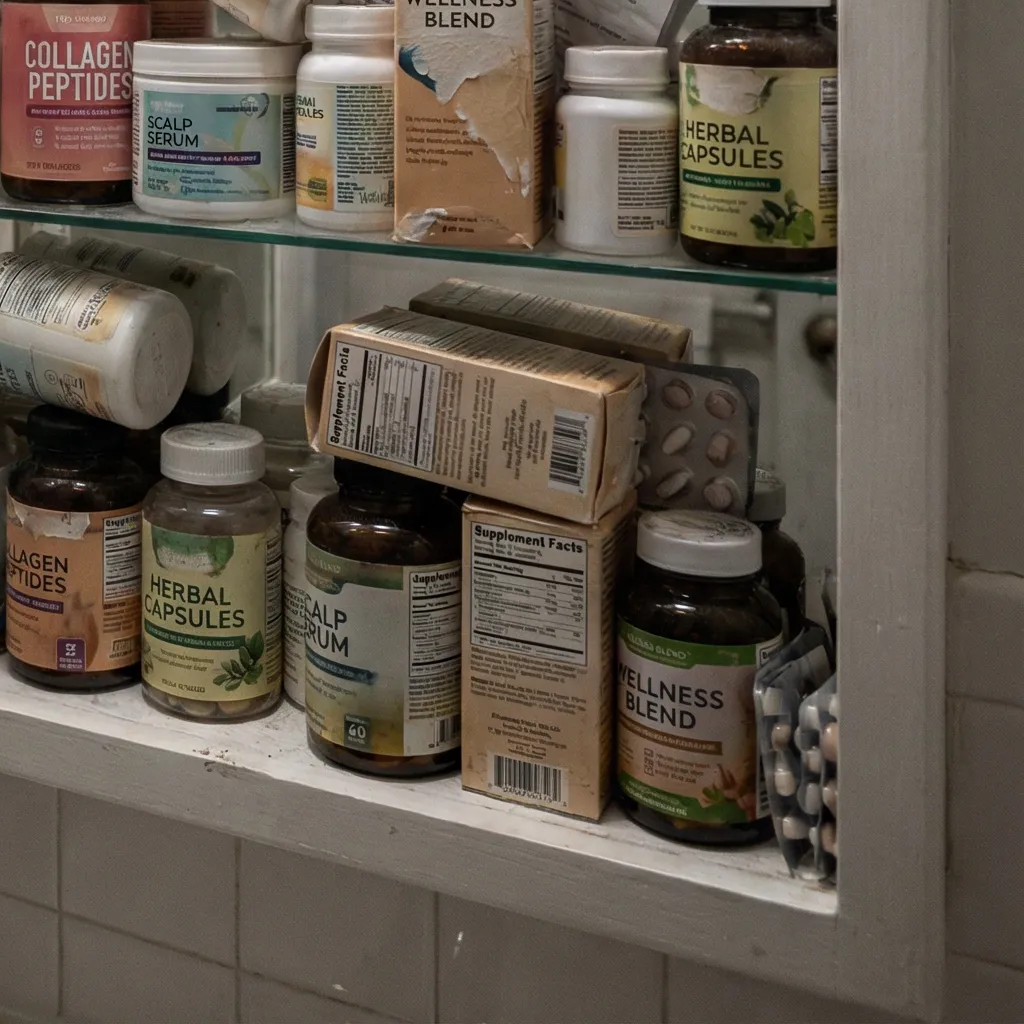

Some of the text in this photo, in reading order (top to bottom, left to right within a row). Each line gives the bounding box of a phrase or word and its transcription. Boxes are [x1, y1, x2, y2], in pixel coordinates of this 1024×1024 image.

[425, 11, 495, 29] BLEND
[26, 40, 133, 69] COLLAGEN
[29, 72, 132, 101] PEPTIDES
[147, 115, 192, 131] SCALP
[686, 119, 769, 145] HERBAL
[147, 132, 199, 148] SERUM
[681, 141, 783, 170] CAPSULES
[548, 537, 583, 553] Facts
[150, 573, 231, 606] HERBAL
[144, 594, 245, 629] CAPSULES
[626, 690, 696, 729] BLEND
